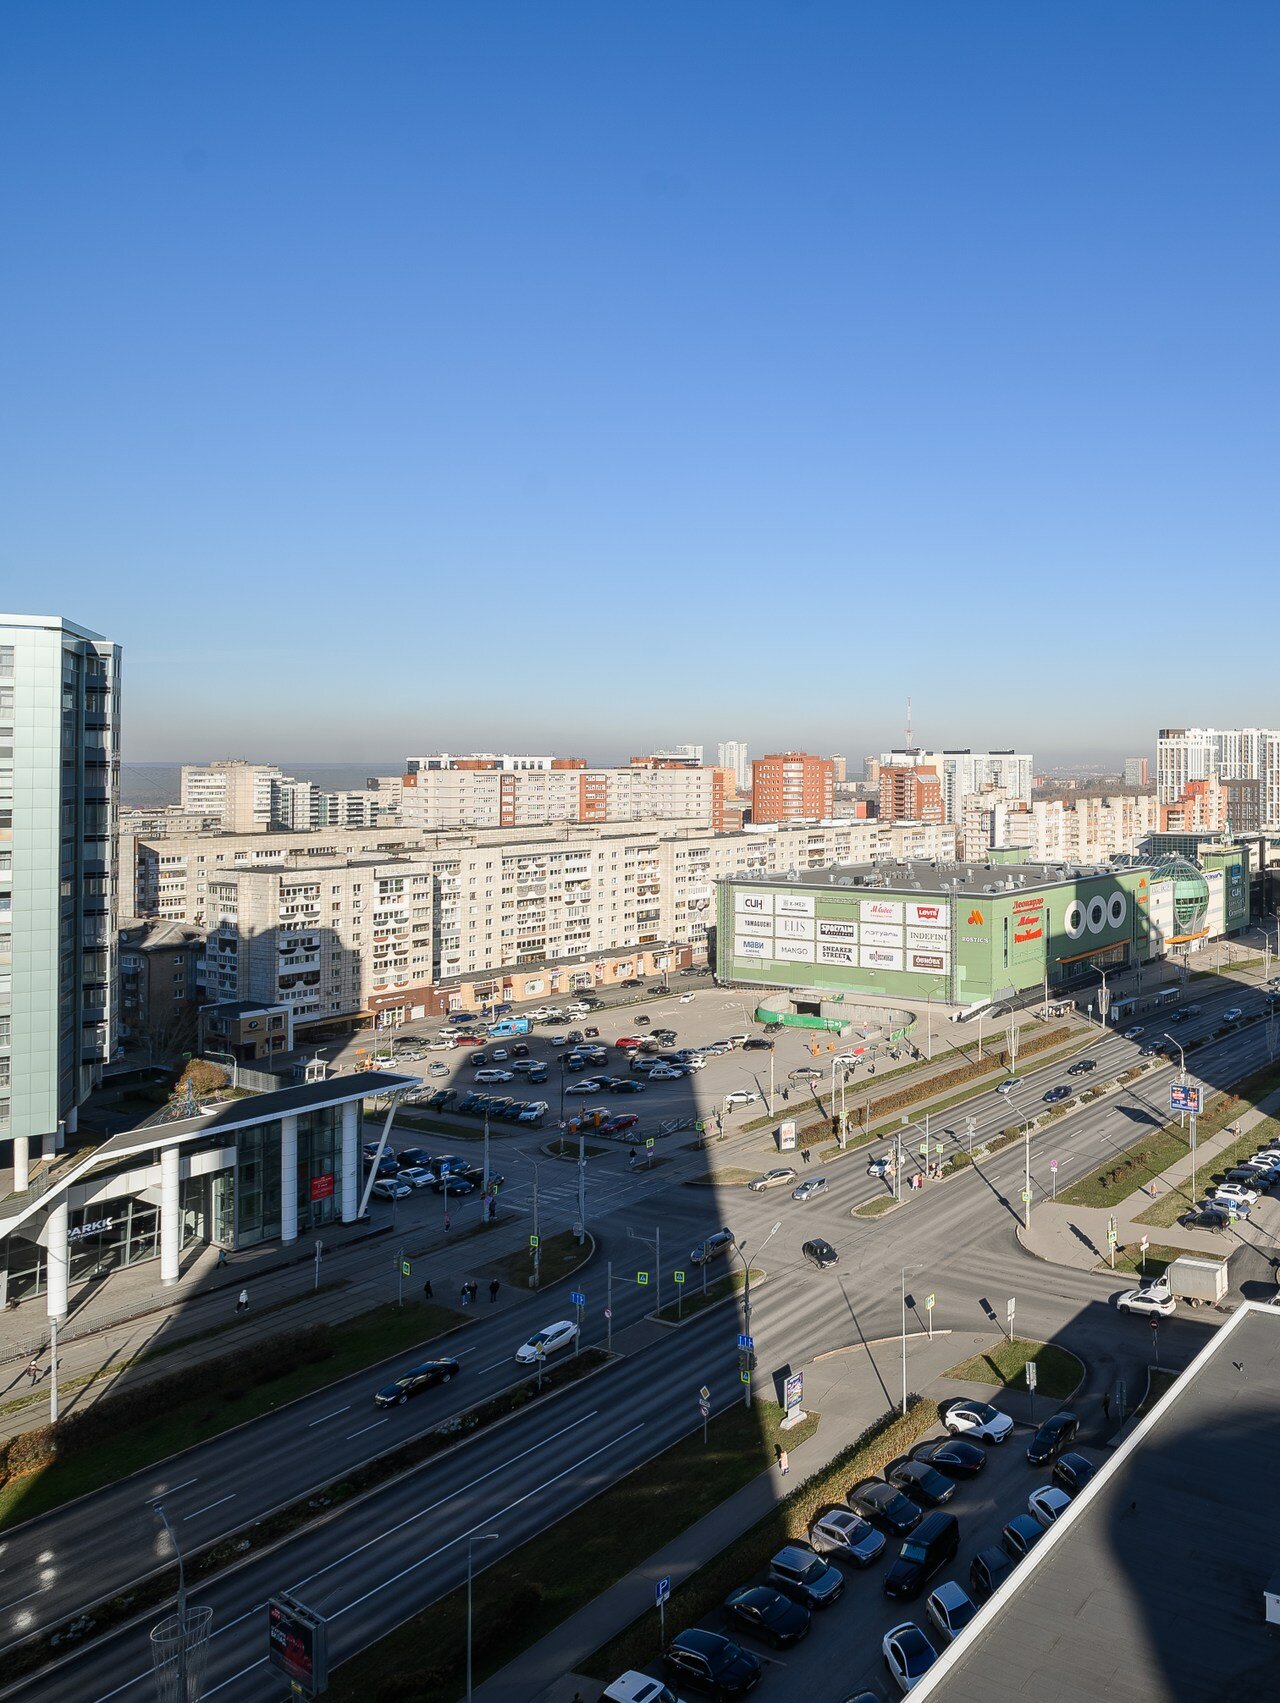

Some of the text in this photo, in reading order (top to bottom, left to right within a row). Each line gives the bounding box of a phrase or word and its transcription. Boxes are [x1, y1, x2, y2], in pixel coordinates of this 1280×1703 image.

[744, 920, 772, 928] YAMAGUCHI
[781, 946, 808, 955] MANGO
[822, 945, 853, 954] SNEAKER
